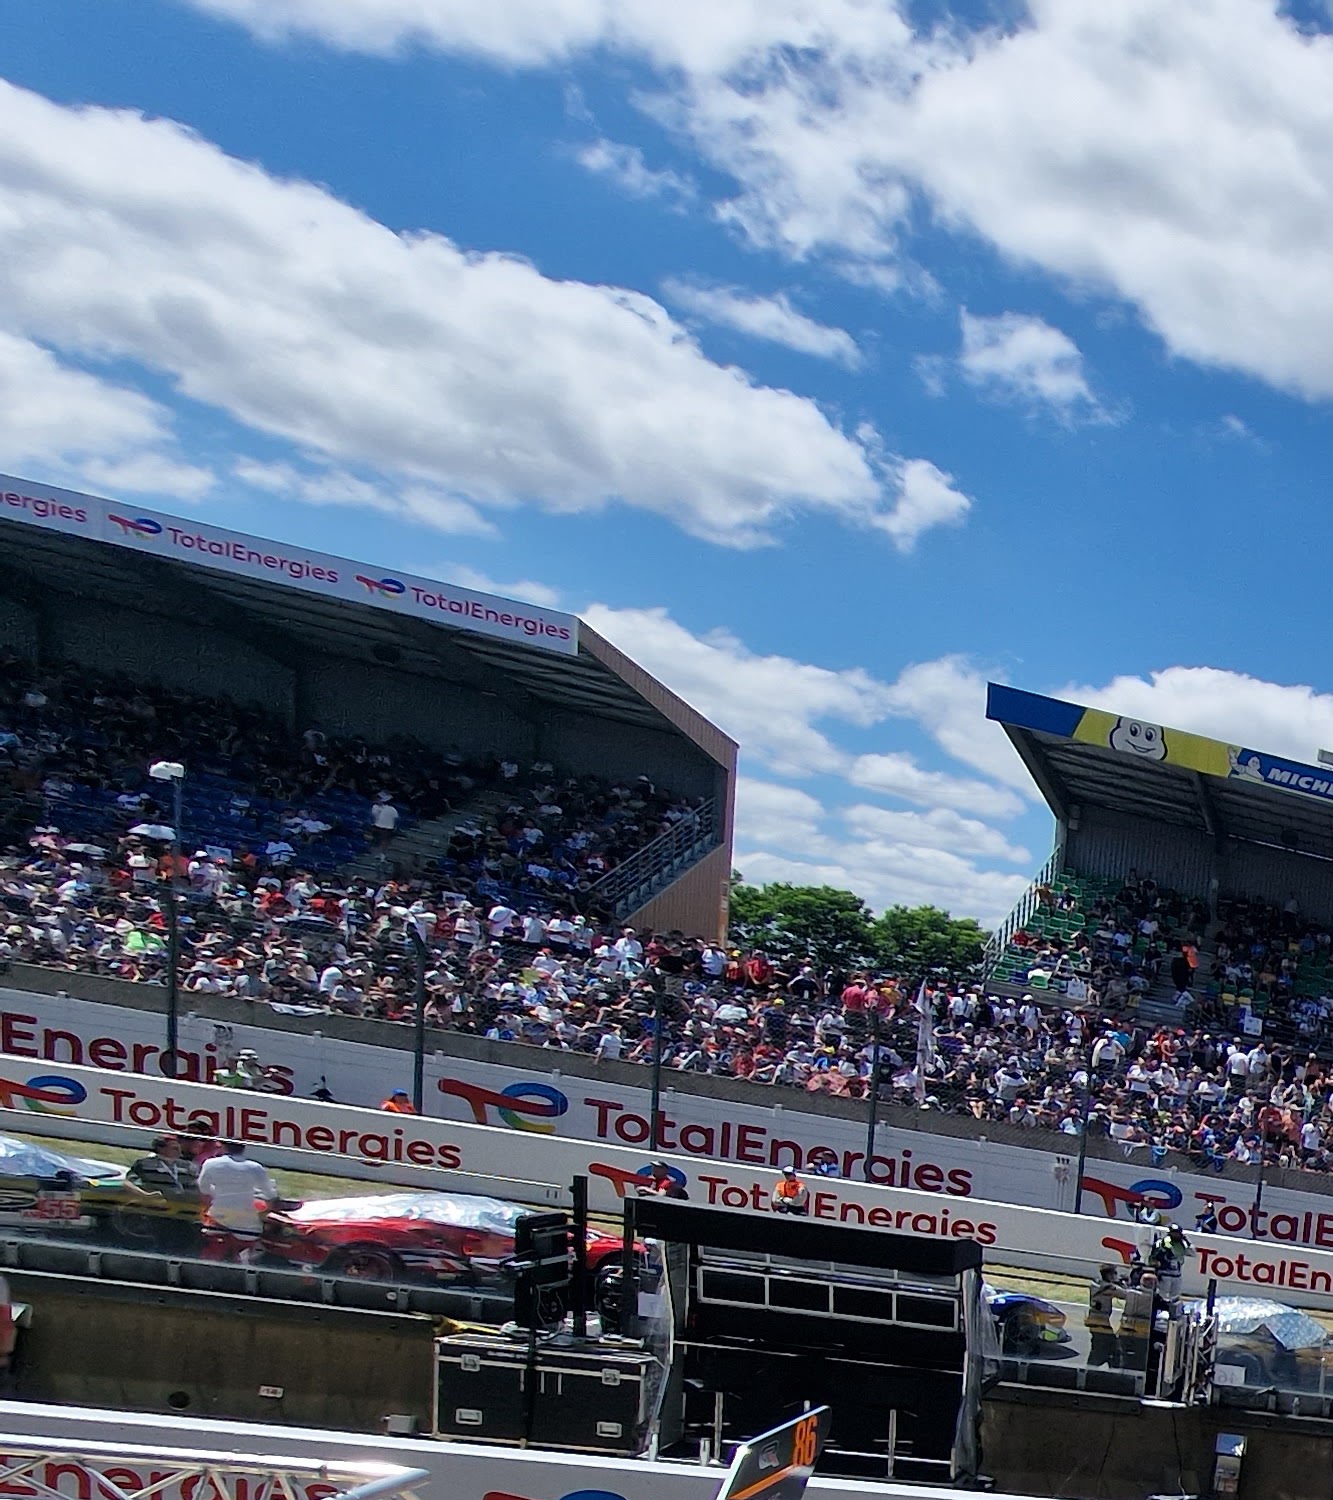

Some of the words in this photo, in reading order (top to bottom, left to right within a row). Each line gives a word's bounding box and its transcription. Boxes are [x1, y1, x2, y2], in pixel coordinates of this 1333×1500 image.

[166, 526, 339, 584] TotalEnergies
[410, 586, 571, 640] TotalEnergies
[792, 1414, 819, 1467] 86
